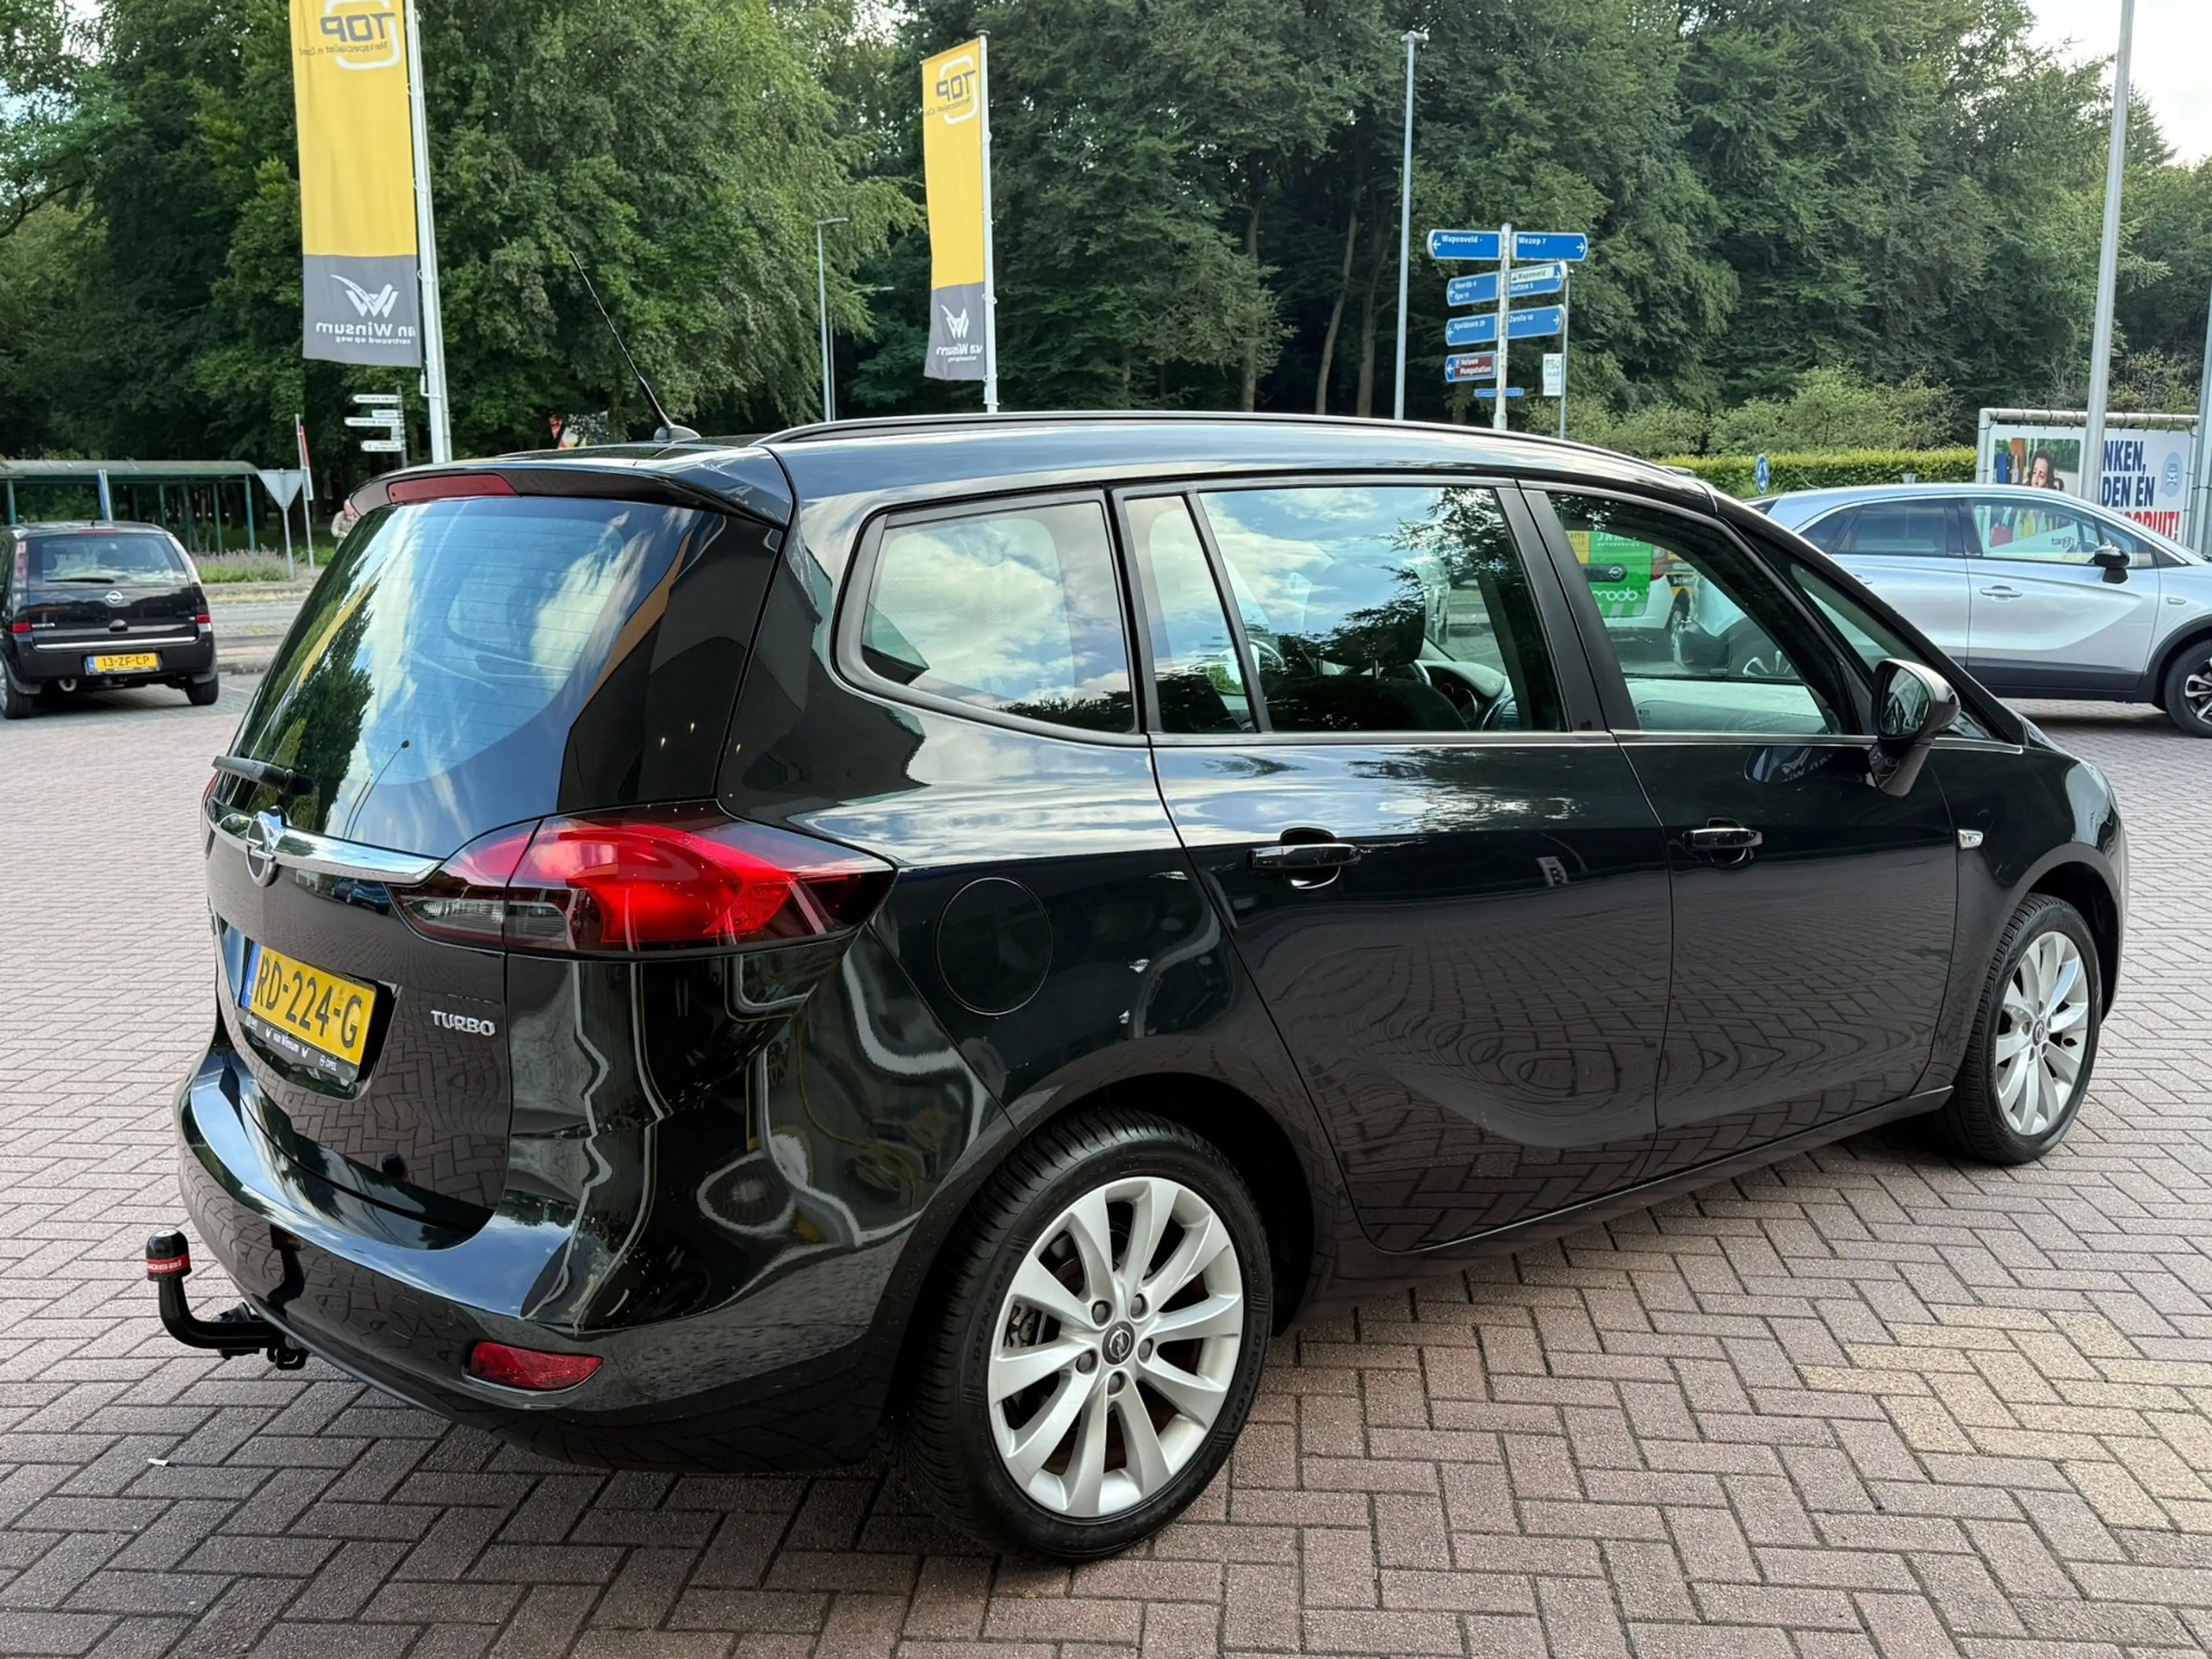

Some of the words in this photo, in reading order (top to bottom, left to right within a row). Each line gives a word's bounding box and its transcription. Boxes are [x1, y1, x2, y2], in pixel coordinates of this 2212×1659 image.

[1441, 235, 1478, 244] Wapenveld
[1518, 237, 1541, 246] Wezep
[253, 953, 362, 1050] RD-224-G
[430, 1009, 497, 1037] TURBO
